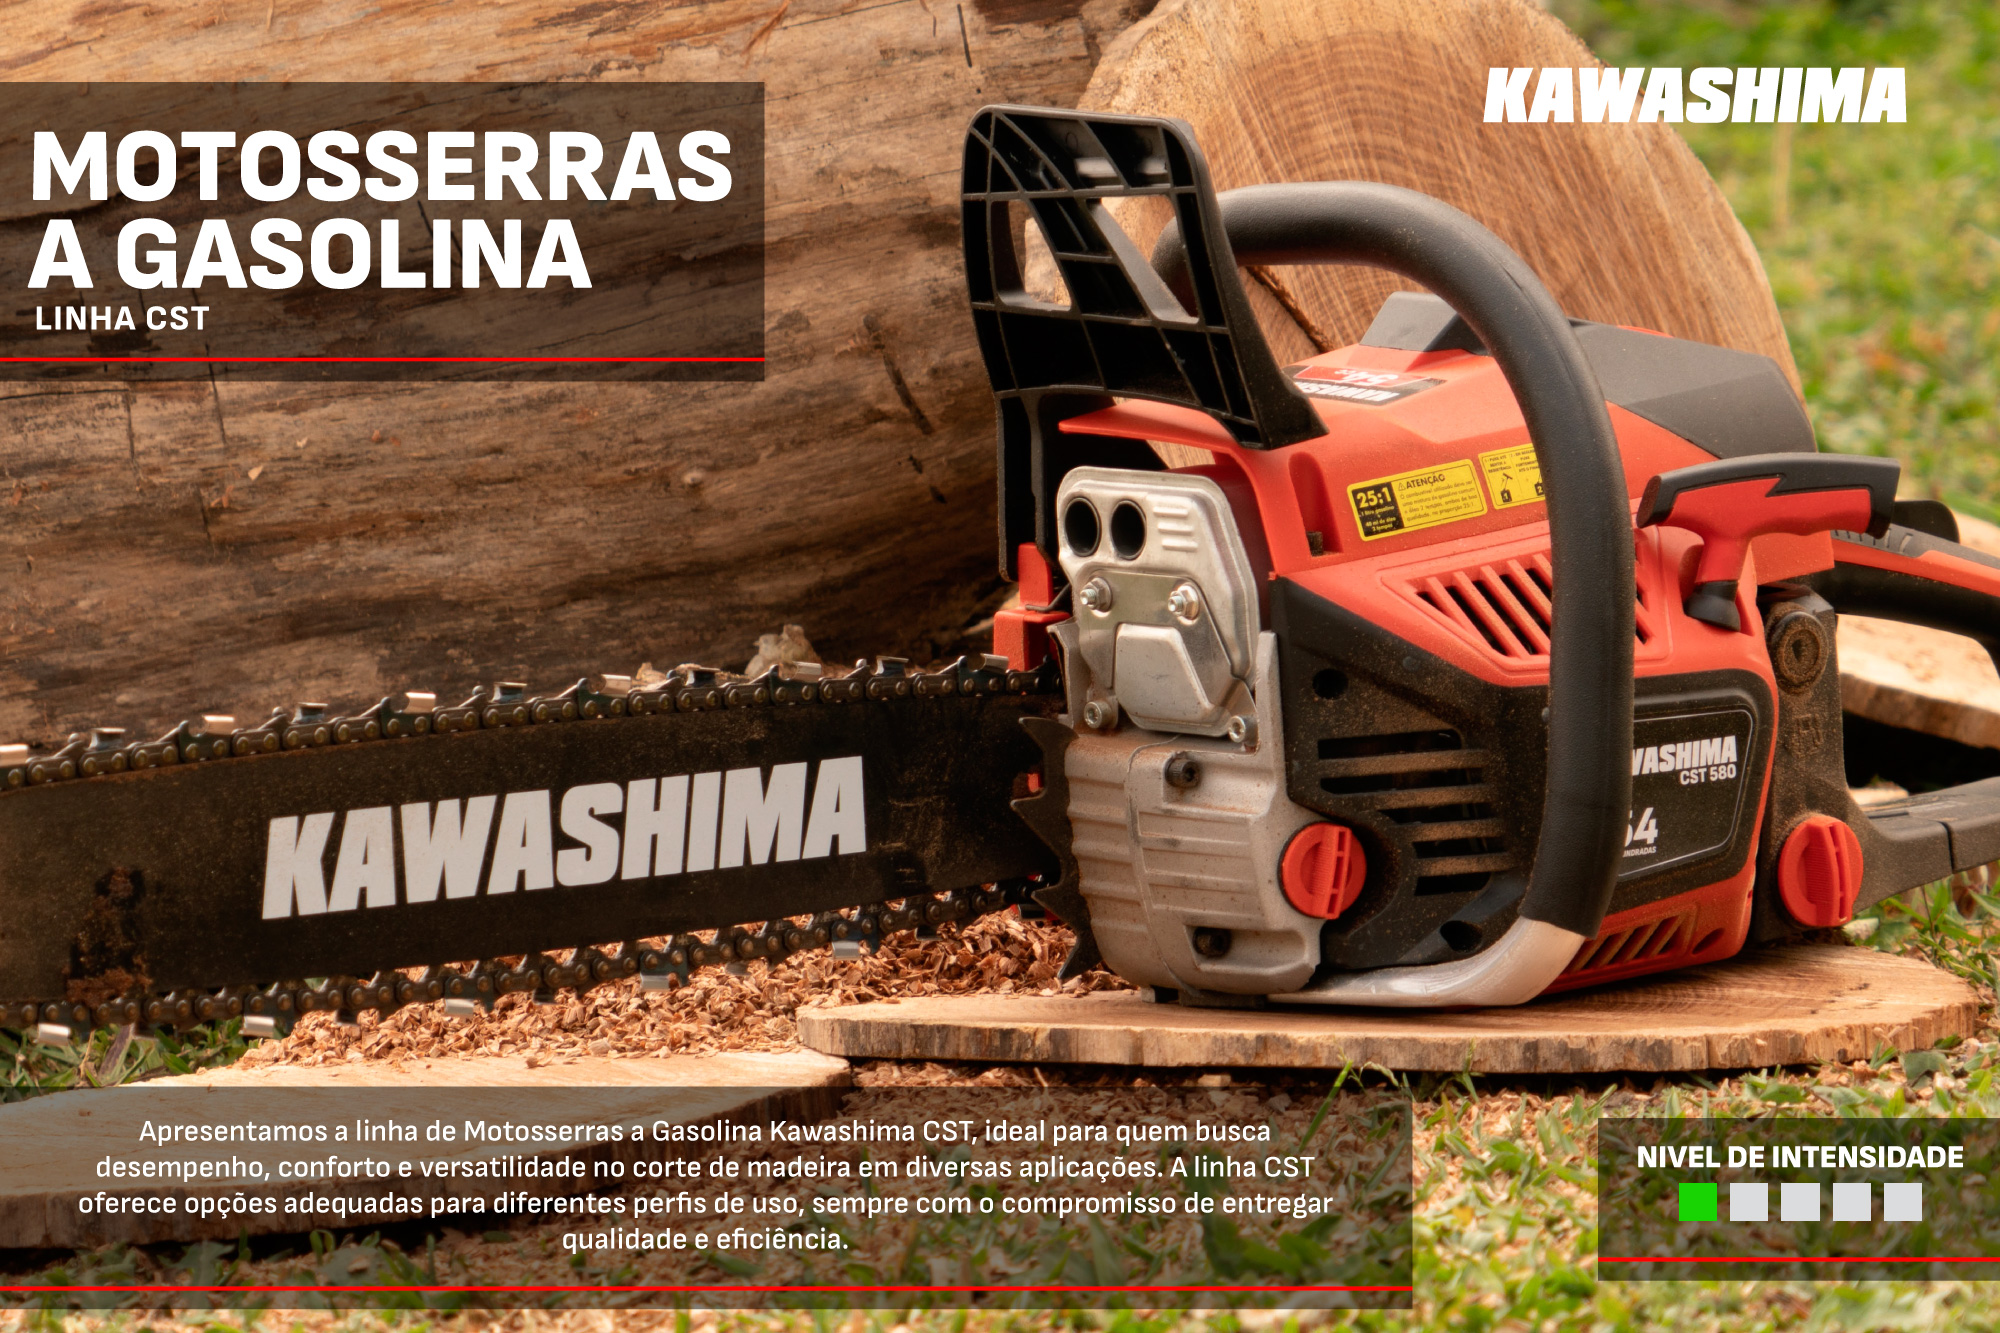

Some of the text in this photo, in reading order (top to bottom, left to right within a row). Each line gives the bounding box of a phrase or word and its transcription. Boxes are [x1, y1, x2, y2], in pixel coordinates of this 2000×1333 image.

[1406, 472, 1446, 489] ATENÇÃO
[1357, 487, 1391, 508] 25:1
[1680, 764, 1737, 785] CST 580
[262, 755, 867, 921] KAWASHIMA
[1623, 846, 1657, 858] INDRADAS
